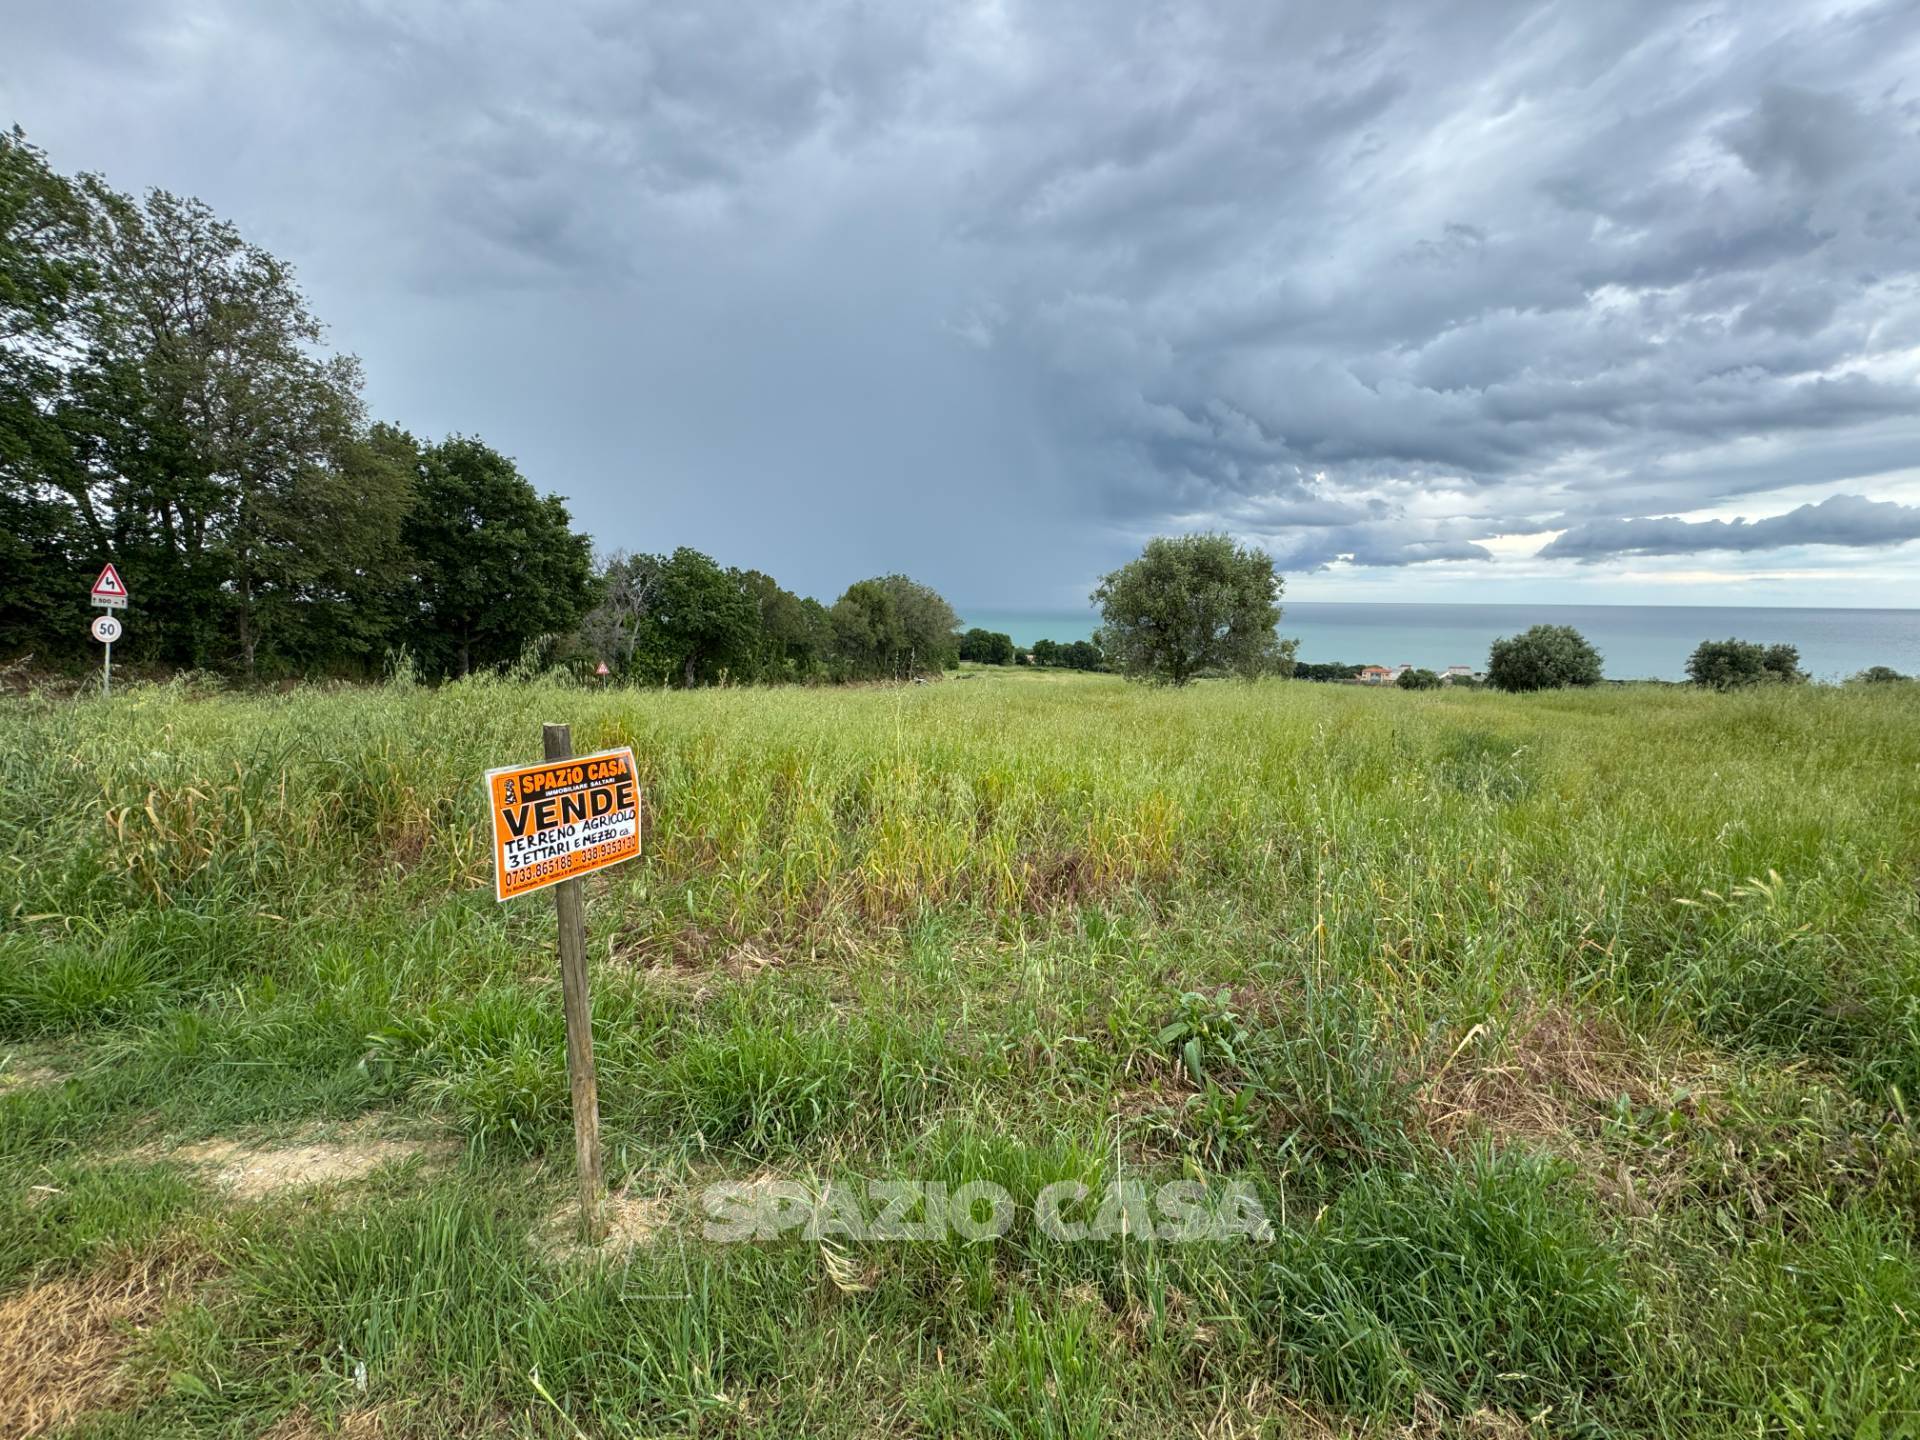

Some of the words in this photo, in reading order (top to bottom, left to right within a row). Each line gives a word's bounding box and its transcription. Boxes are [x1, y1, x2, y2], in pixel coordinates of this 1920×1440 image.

[99, 623, 115, 635] 50
[587, 759, 627, 781] CASA
[545, 783, 588, 797] IMMOBILIARE
[590, 777, 616, 788] SALTARI
[502, 783, 635, 837] VENDE
[505, 825, 576, 853] TERRENO
[582, 810, 636, 834] AGRICOLO
[509, 855, 521, 868] 3
[523, 841, 570, 865] ETTARI
[574, 838, 581, 848] E
[582, 829, 617, 846] MEZZO
